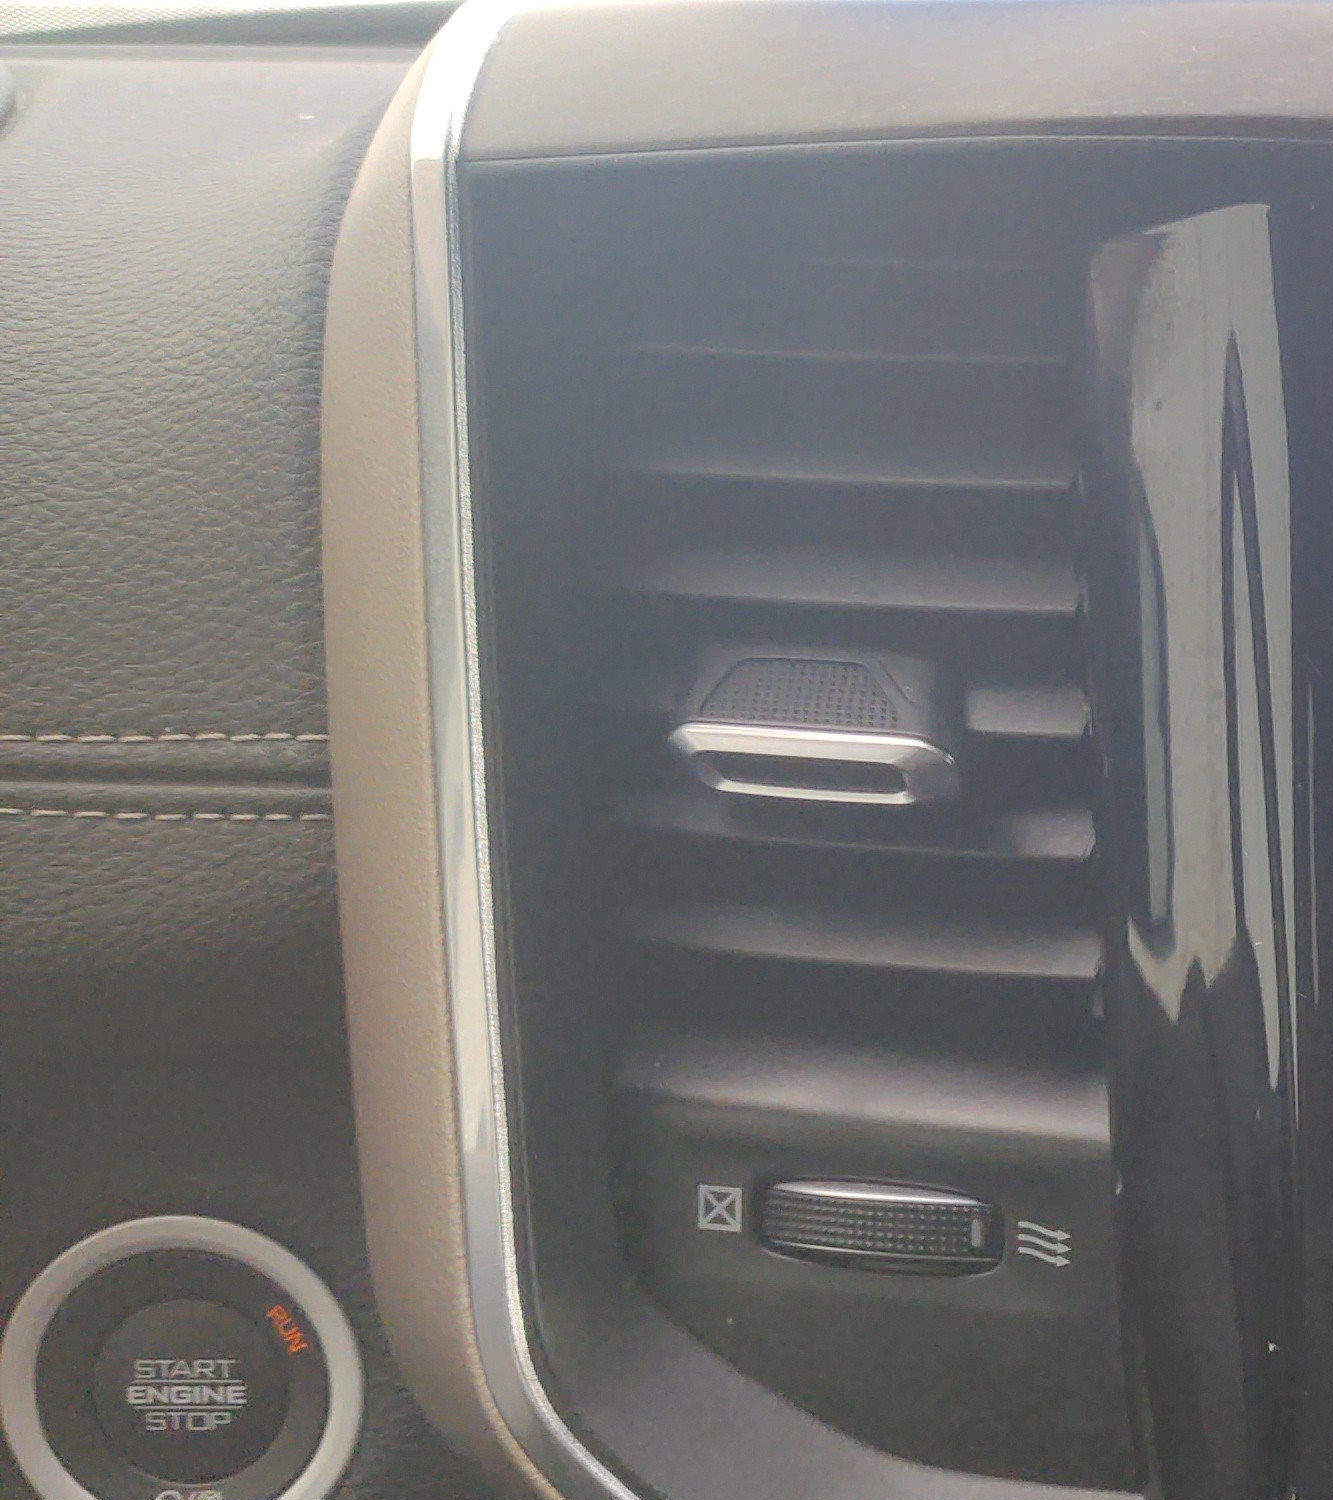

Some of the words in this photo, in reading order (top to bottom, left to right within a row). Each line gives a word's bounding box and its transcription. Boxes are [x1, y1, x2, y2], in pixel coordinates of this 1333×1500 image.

[266, 1304, 309, 1354] RUN
[134, 1359, 240, 1379] START
[126, 1385, 248, 1405] ENGINE
[146, 1411, 232, 1431] STOP
